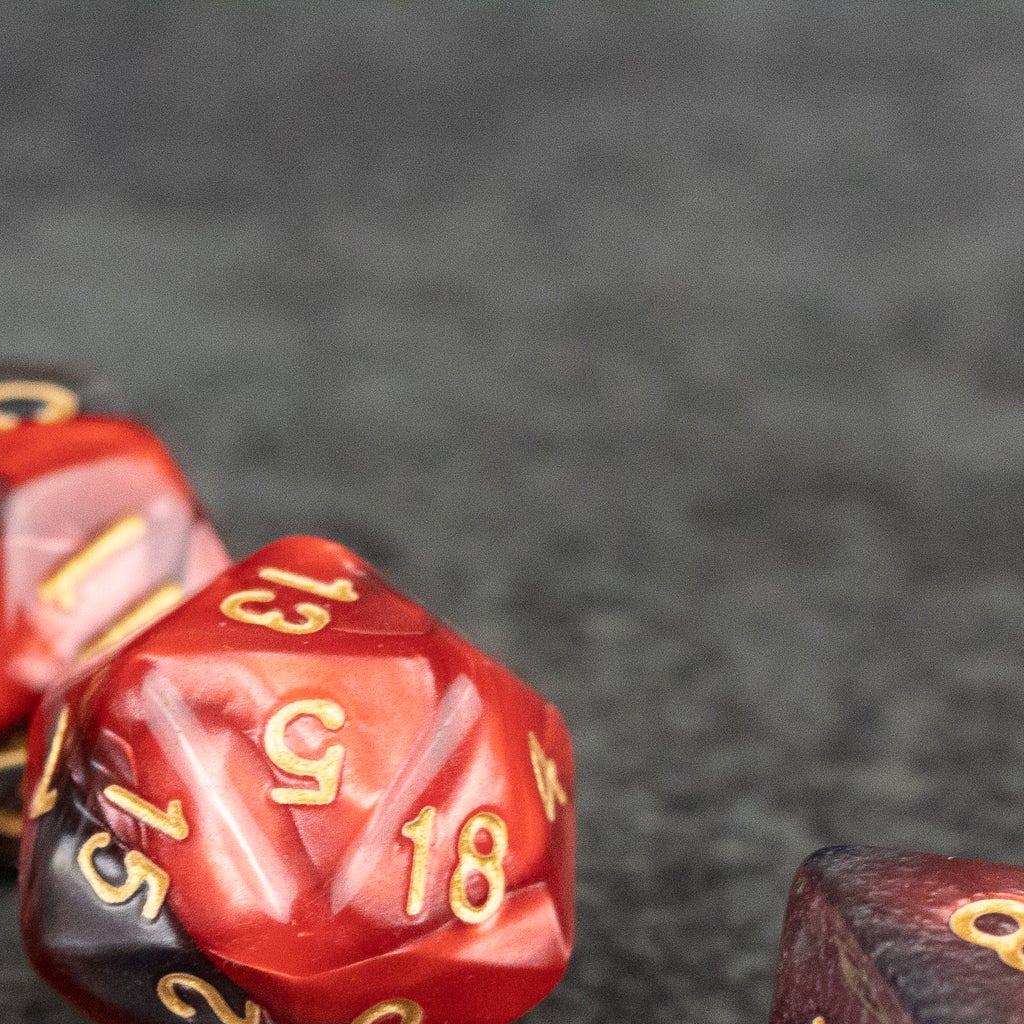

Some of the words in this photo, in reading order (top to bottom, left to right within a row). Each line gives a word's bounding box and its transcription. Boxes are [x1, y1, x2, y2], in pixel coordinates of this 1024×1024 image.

[220, 567, 359, 634] 13
[265, 699, 345, 804] 5
[77, 785, 188, 921] 15
[402, 806, 507, 924] 18
